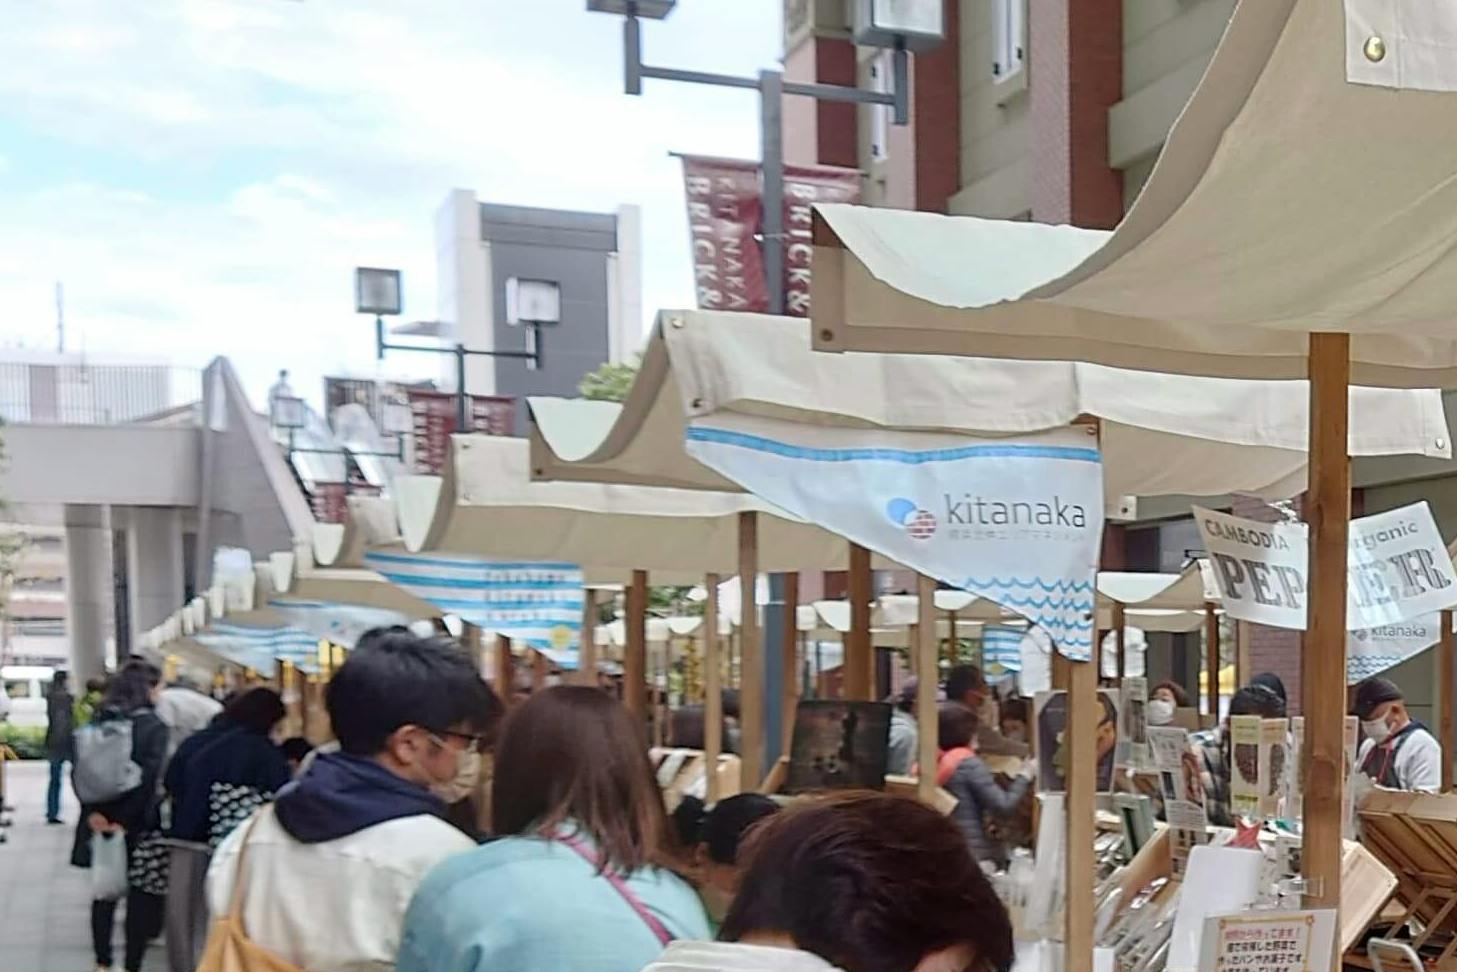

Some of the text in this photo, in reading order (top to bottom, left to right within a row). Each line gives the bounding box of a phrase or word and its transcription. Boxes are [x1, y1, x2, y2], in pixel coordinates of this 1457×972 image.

[944, 494, 1086, 528] kitanaka
[1205, 519, 1419, 551] CAMBODIA rganic
